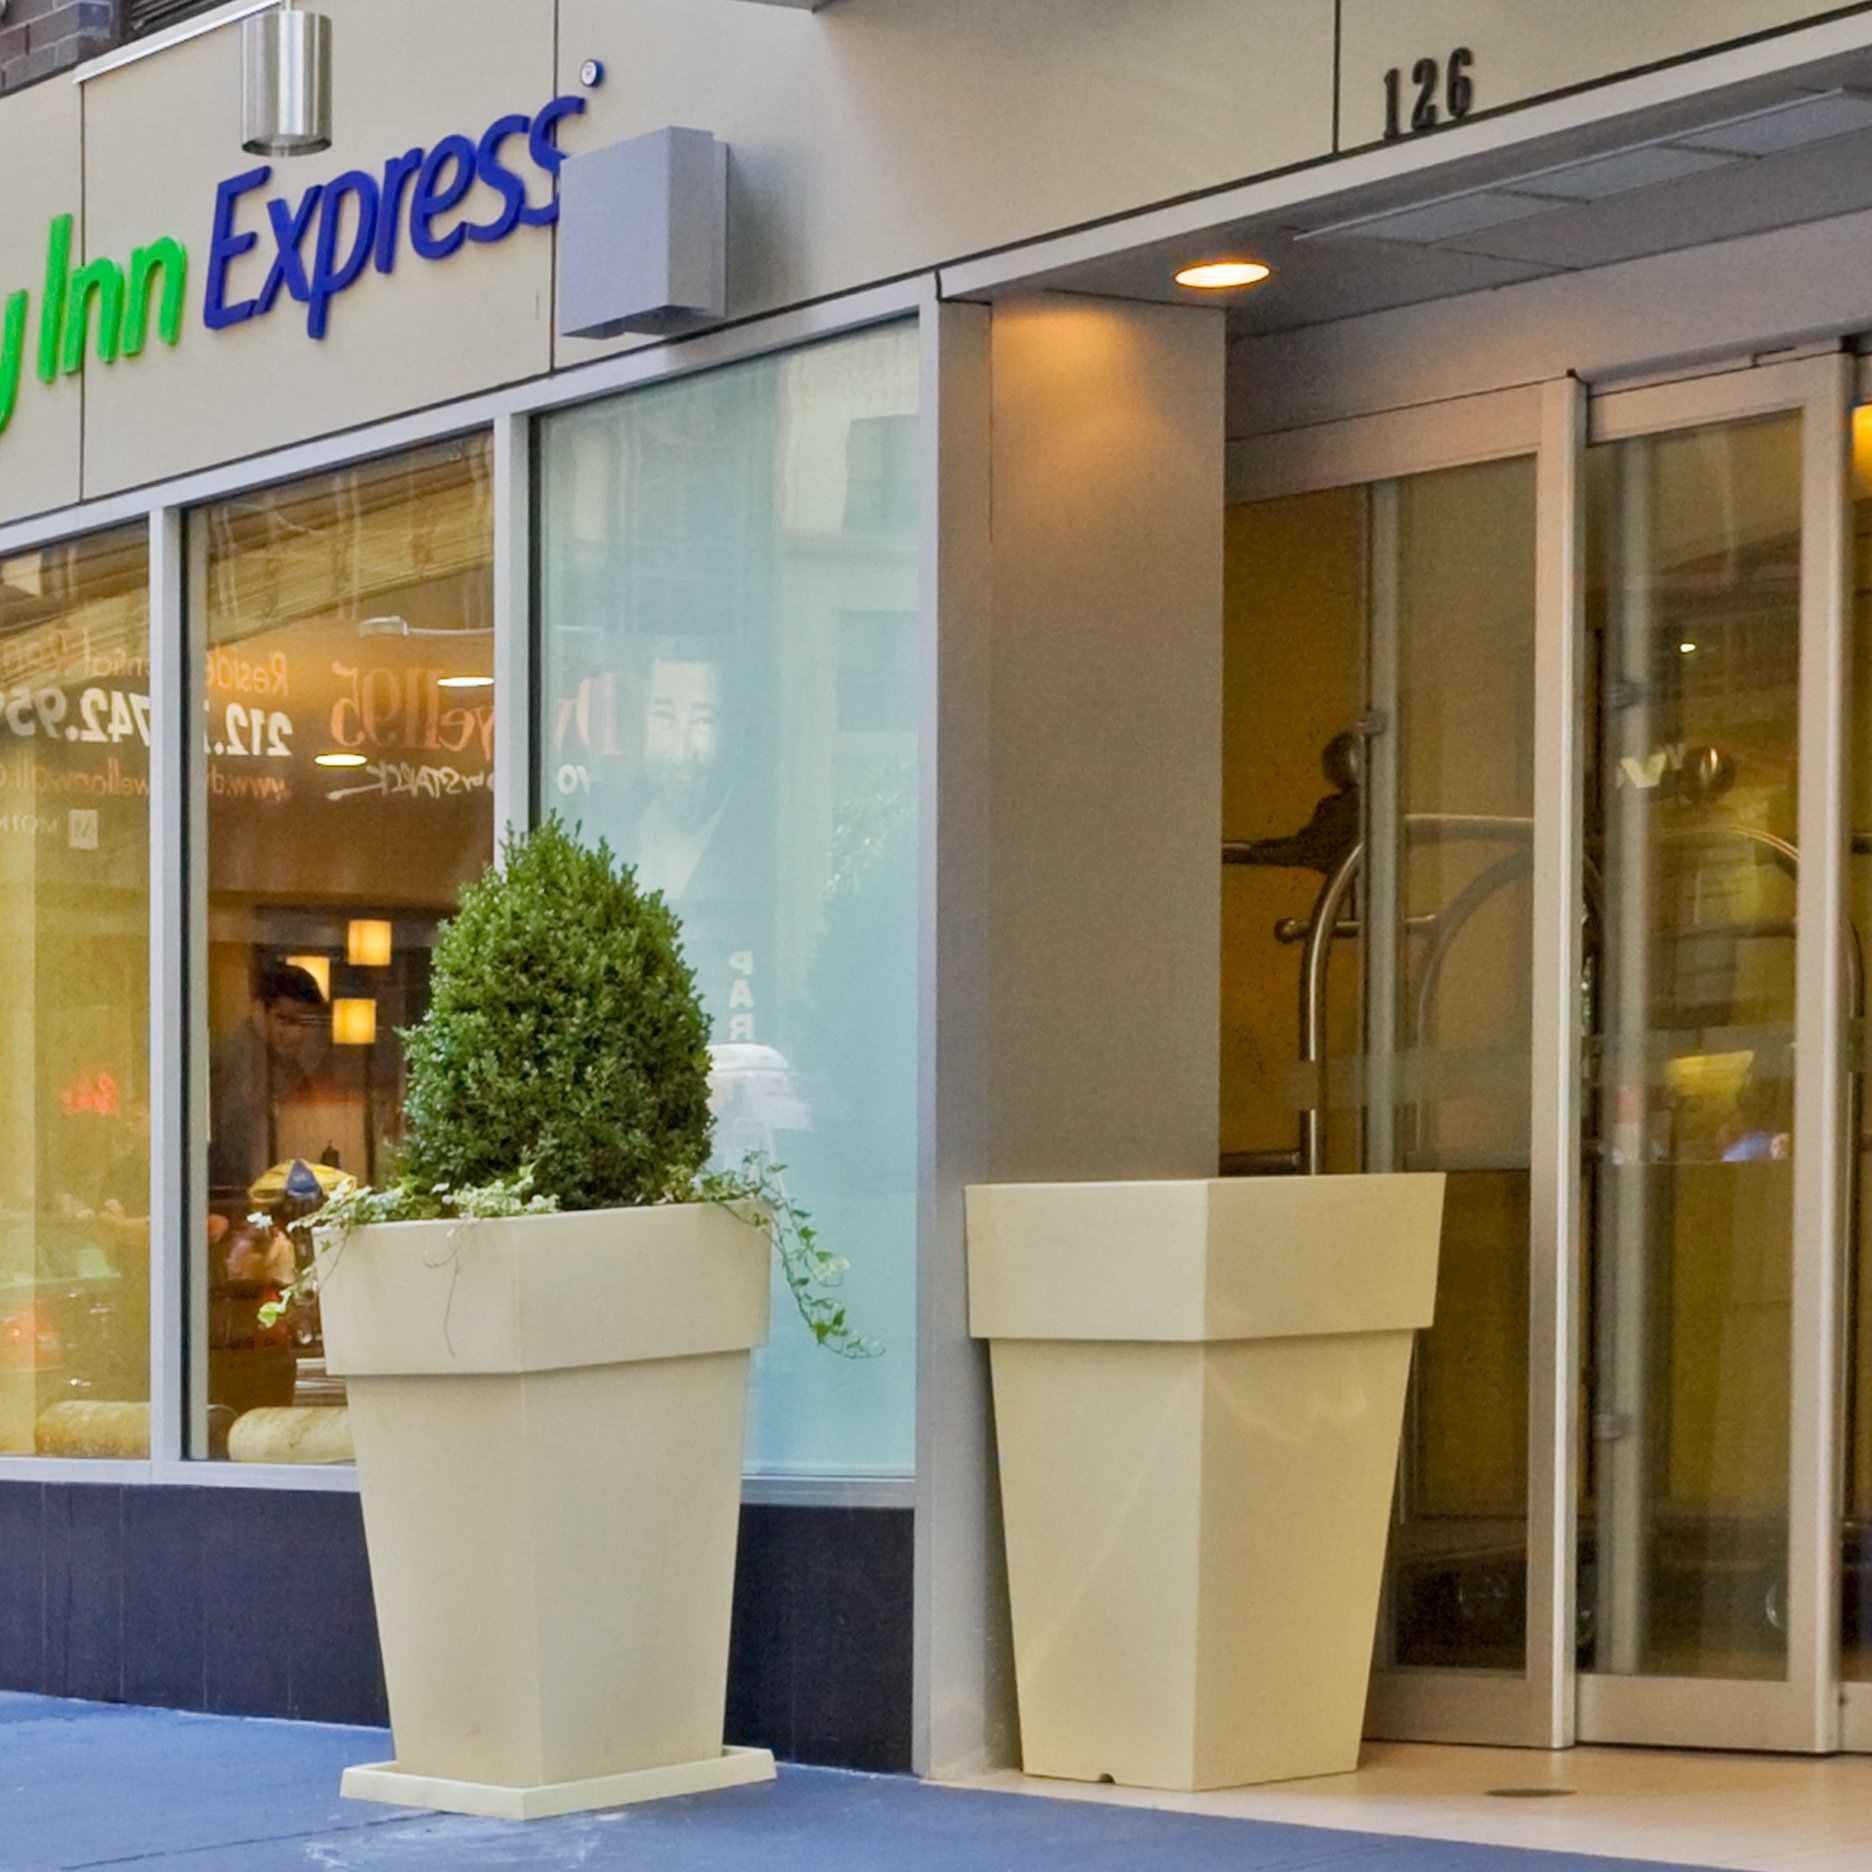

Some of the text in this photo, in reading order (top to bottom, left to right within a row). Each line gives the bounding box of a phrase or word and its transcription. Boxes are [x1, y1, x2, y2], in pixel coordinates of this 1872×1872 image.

[1383, 46, 1474, 140] 126
[37, 213, 186, 384] Inn
[204, 96, 586, 339] Express
